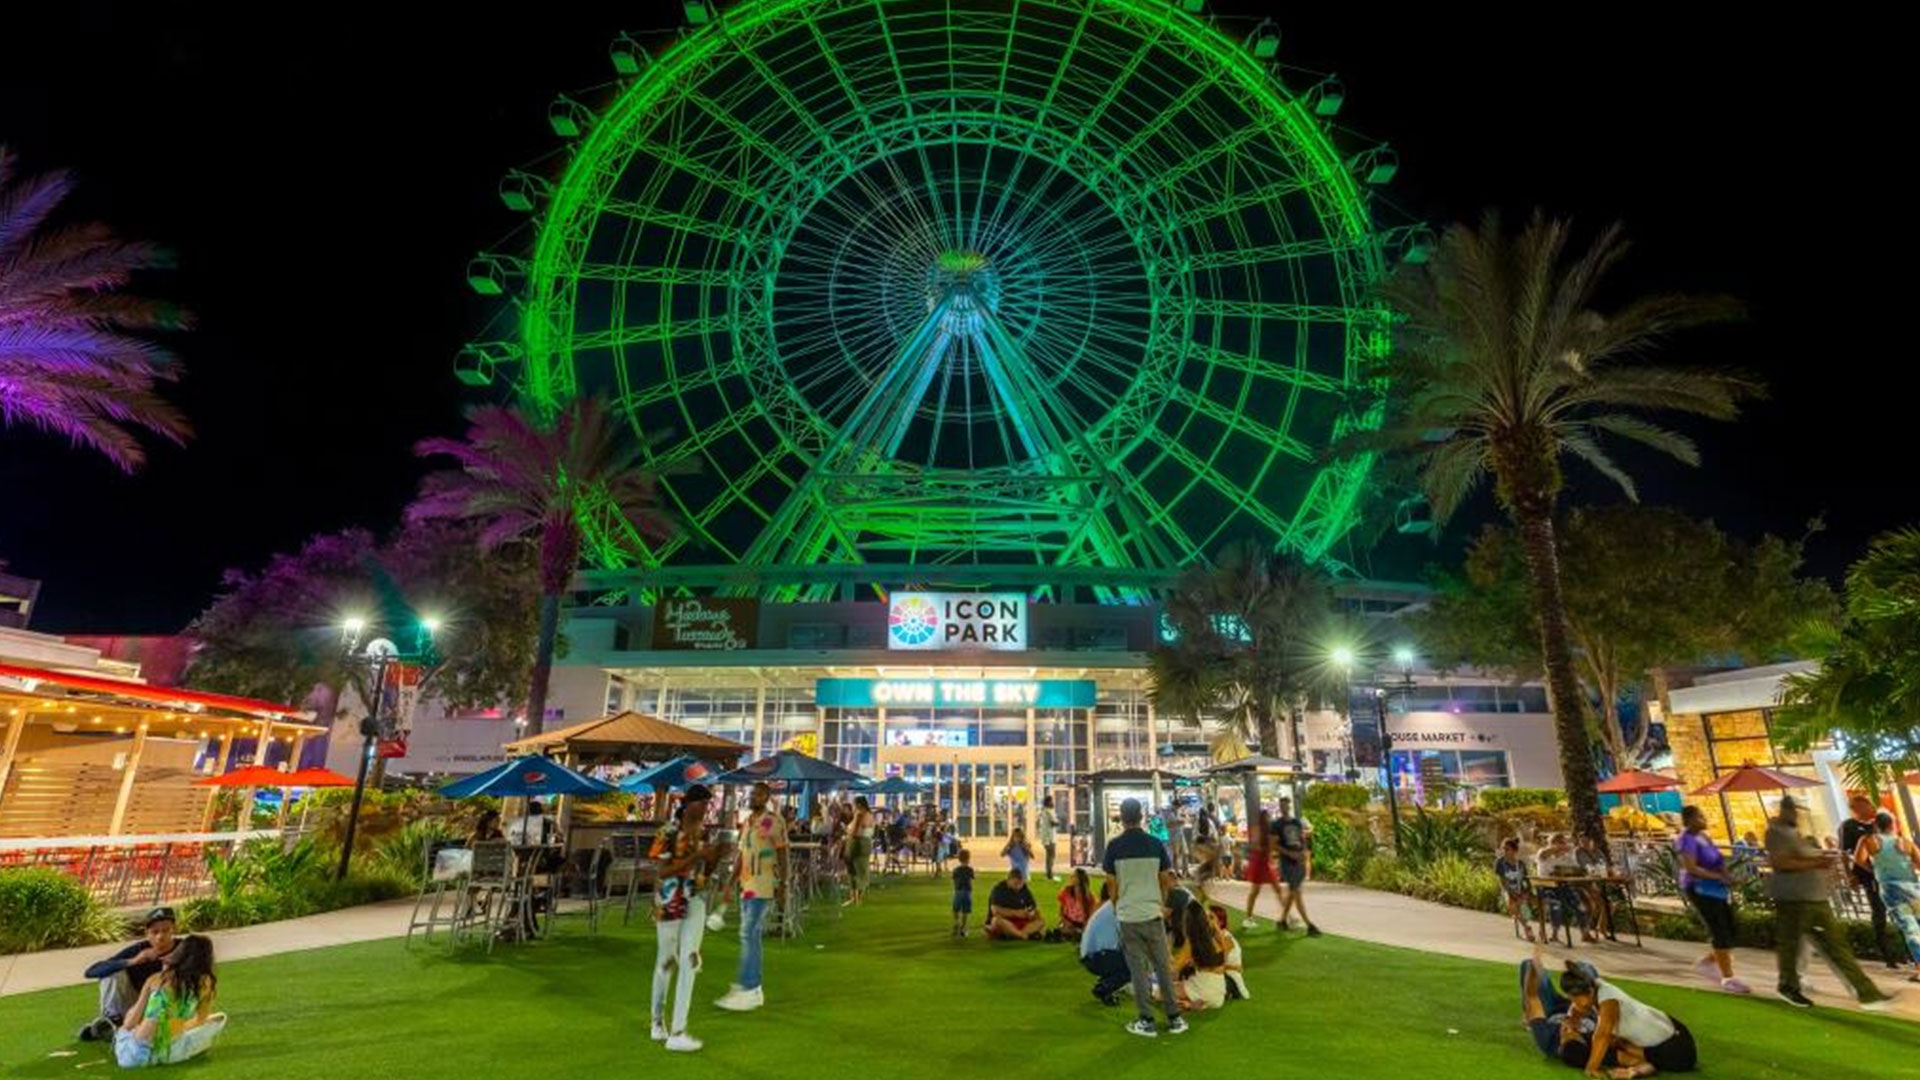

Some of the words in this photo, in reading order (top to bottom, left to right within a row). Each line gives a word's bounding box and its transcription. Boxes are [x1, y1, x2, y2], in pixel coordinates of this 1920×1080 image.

[945, 600, 1018, 619] ICON
[945, 624, 1018, 642] PARK
[874, 682, 933, 702] OWN
[941, 682, 986, 702] THE
[993, 682, 1038, 702] SKY
[1391, 732, 1419, 742] OUSE
[1421, 732, 1466, 742] MARKET
